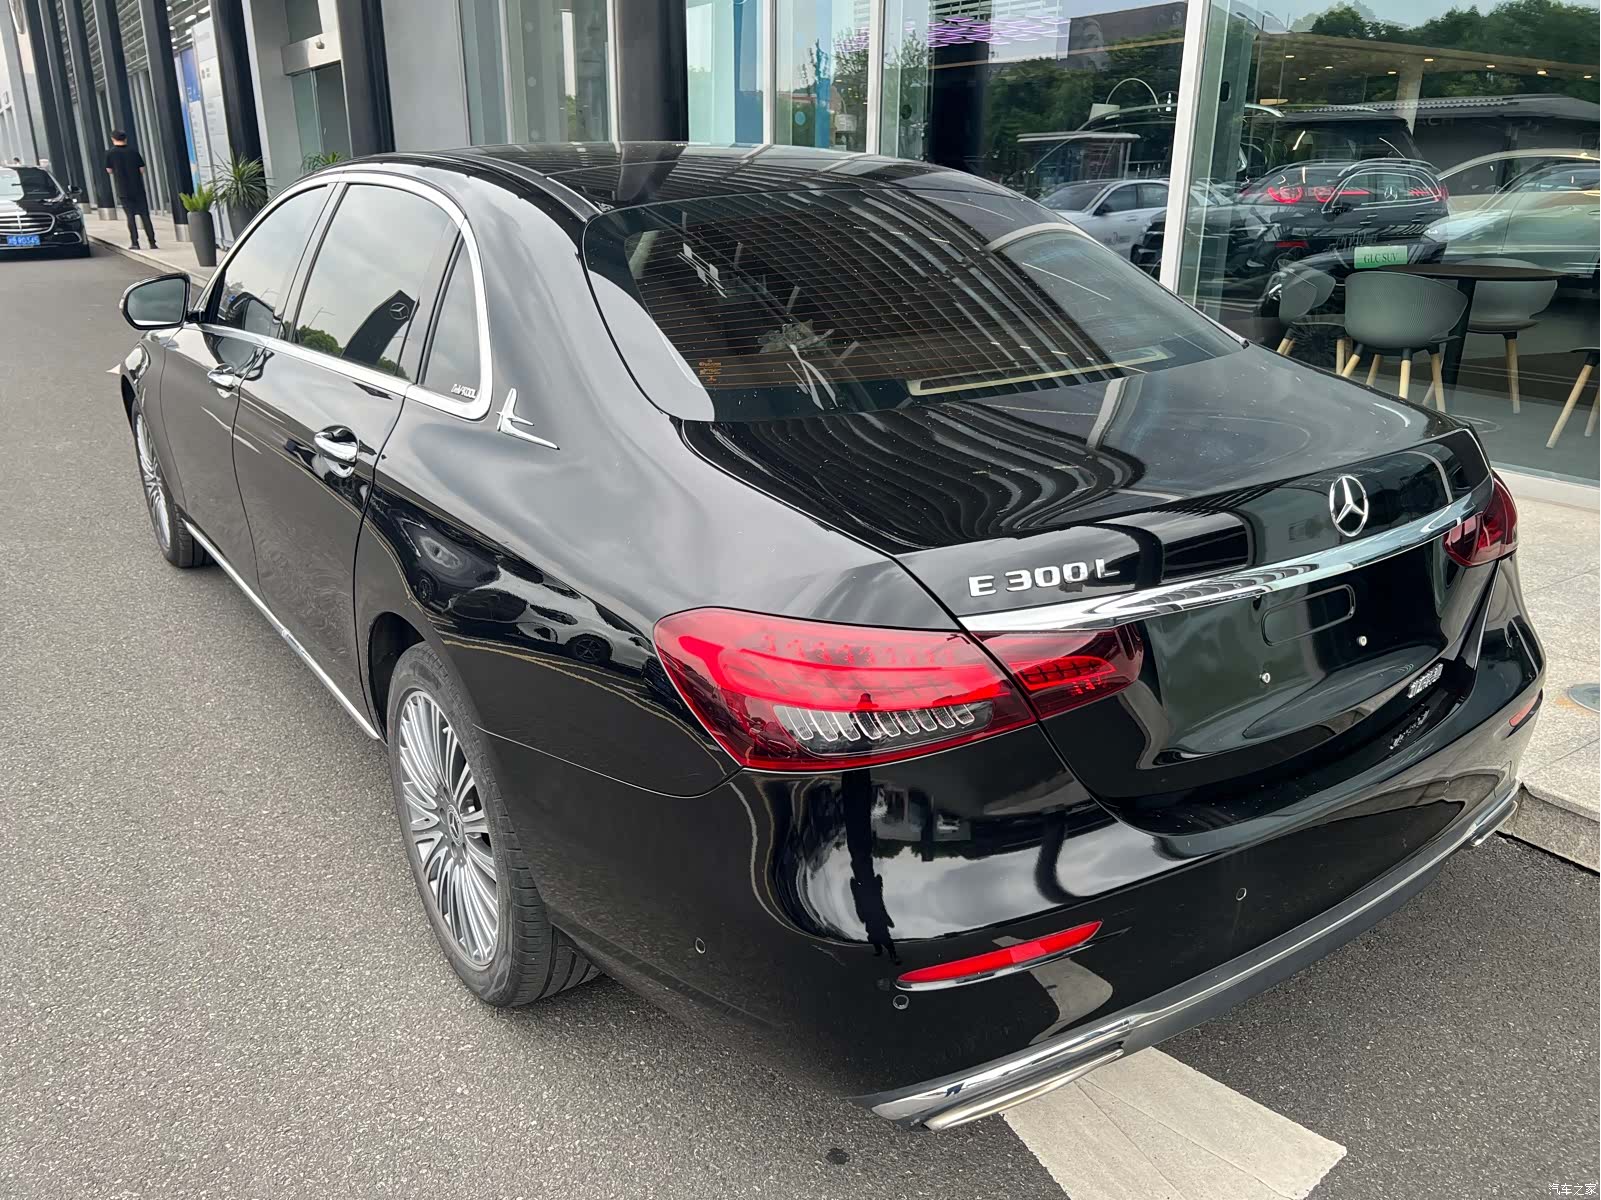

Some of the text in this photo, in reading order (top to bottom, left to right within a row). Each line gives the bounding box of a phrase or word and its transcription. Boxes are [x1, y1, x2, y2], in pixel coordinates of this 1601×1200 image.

[1363, 252, 1399, 264] GLC SUV
[968, 558, 1121, 597] E 300 L
